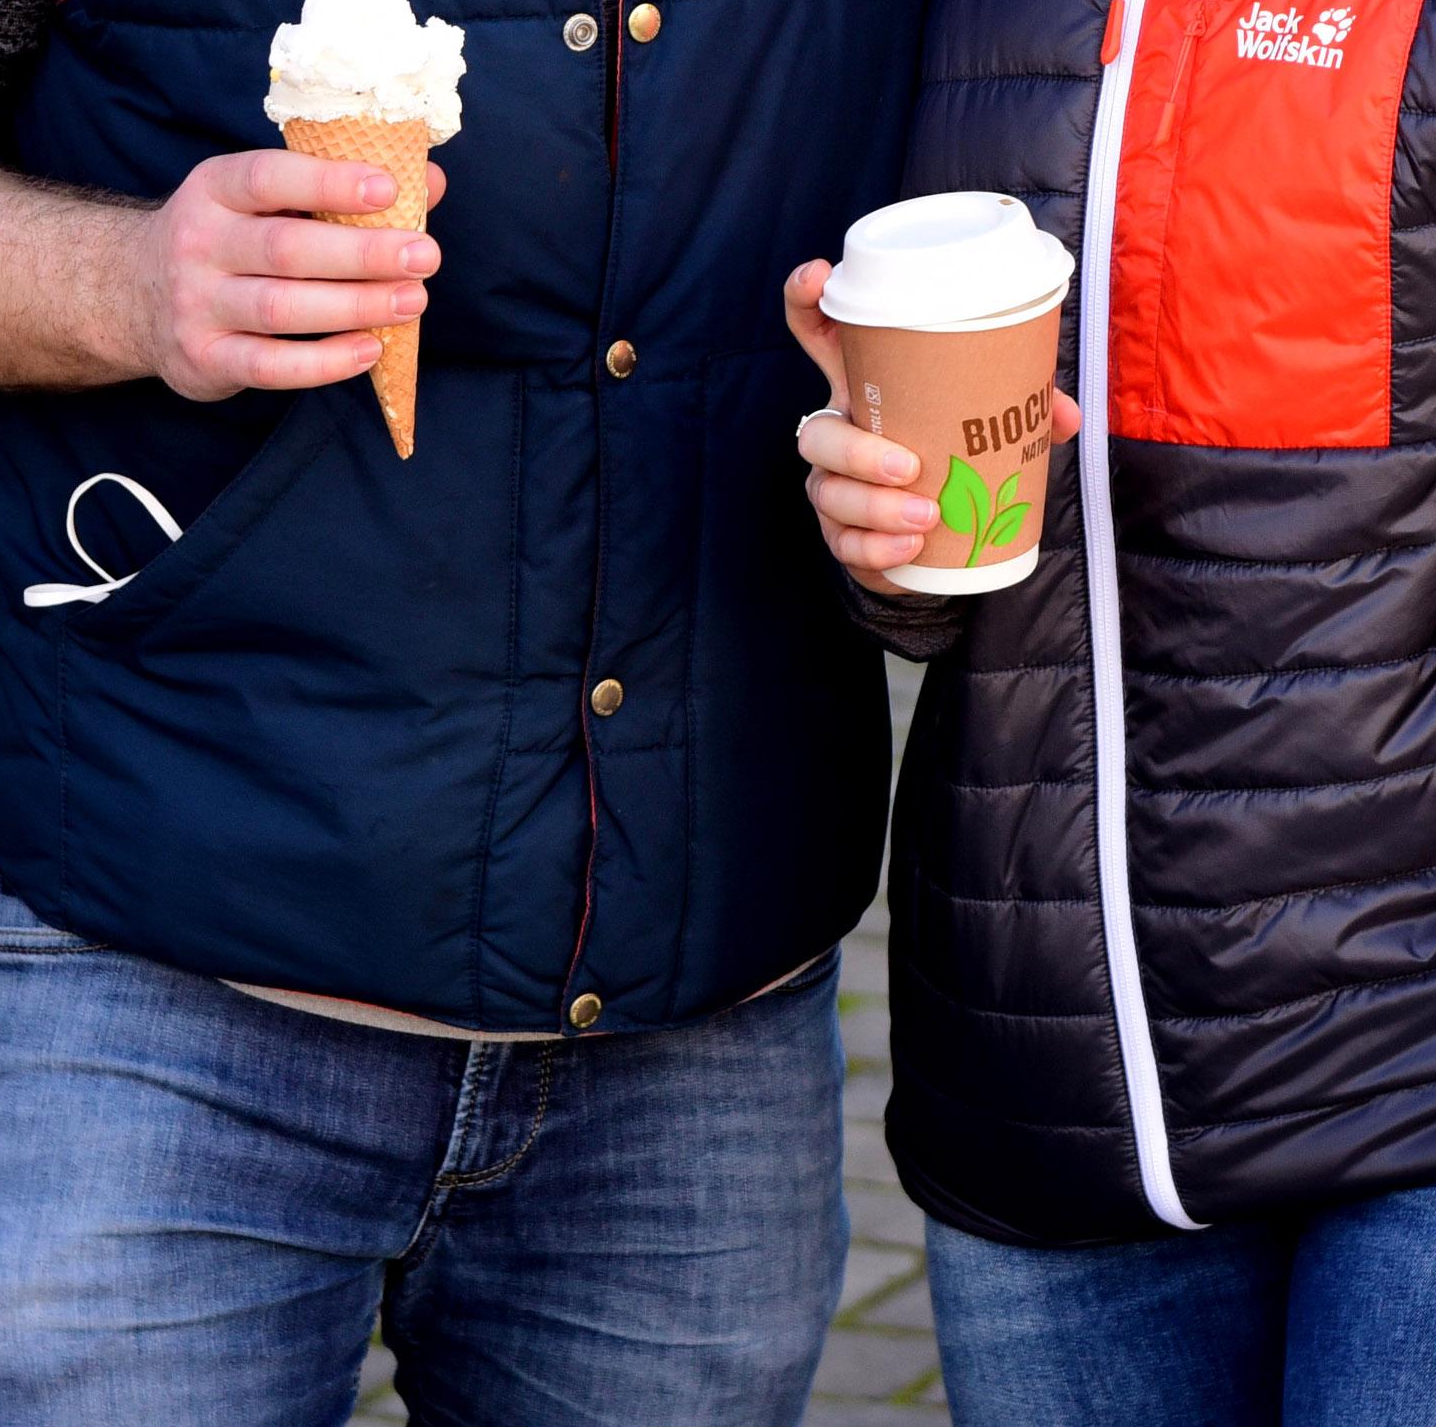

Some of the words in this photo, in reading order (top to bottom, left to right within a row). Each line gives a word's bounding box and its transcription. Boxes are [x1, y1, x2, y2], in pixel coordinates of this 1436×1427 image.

[1239, 1, 1305, 34] Jack
[1236, 28, 1344, 69] Wolfskin
[962, 371, 1056, 457] BIOCU
